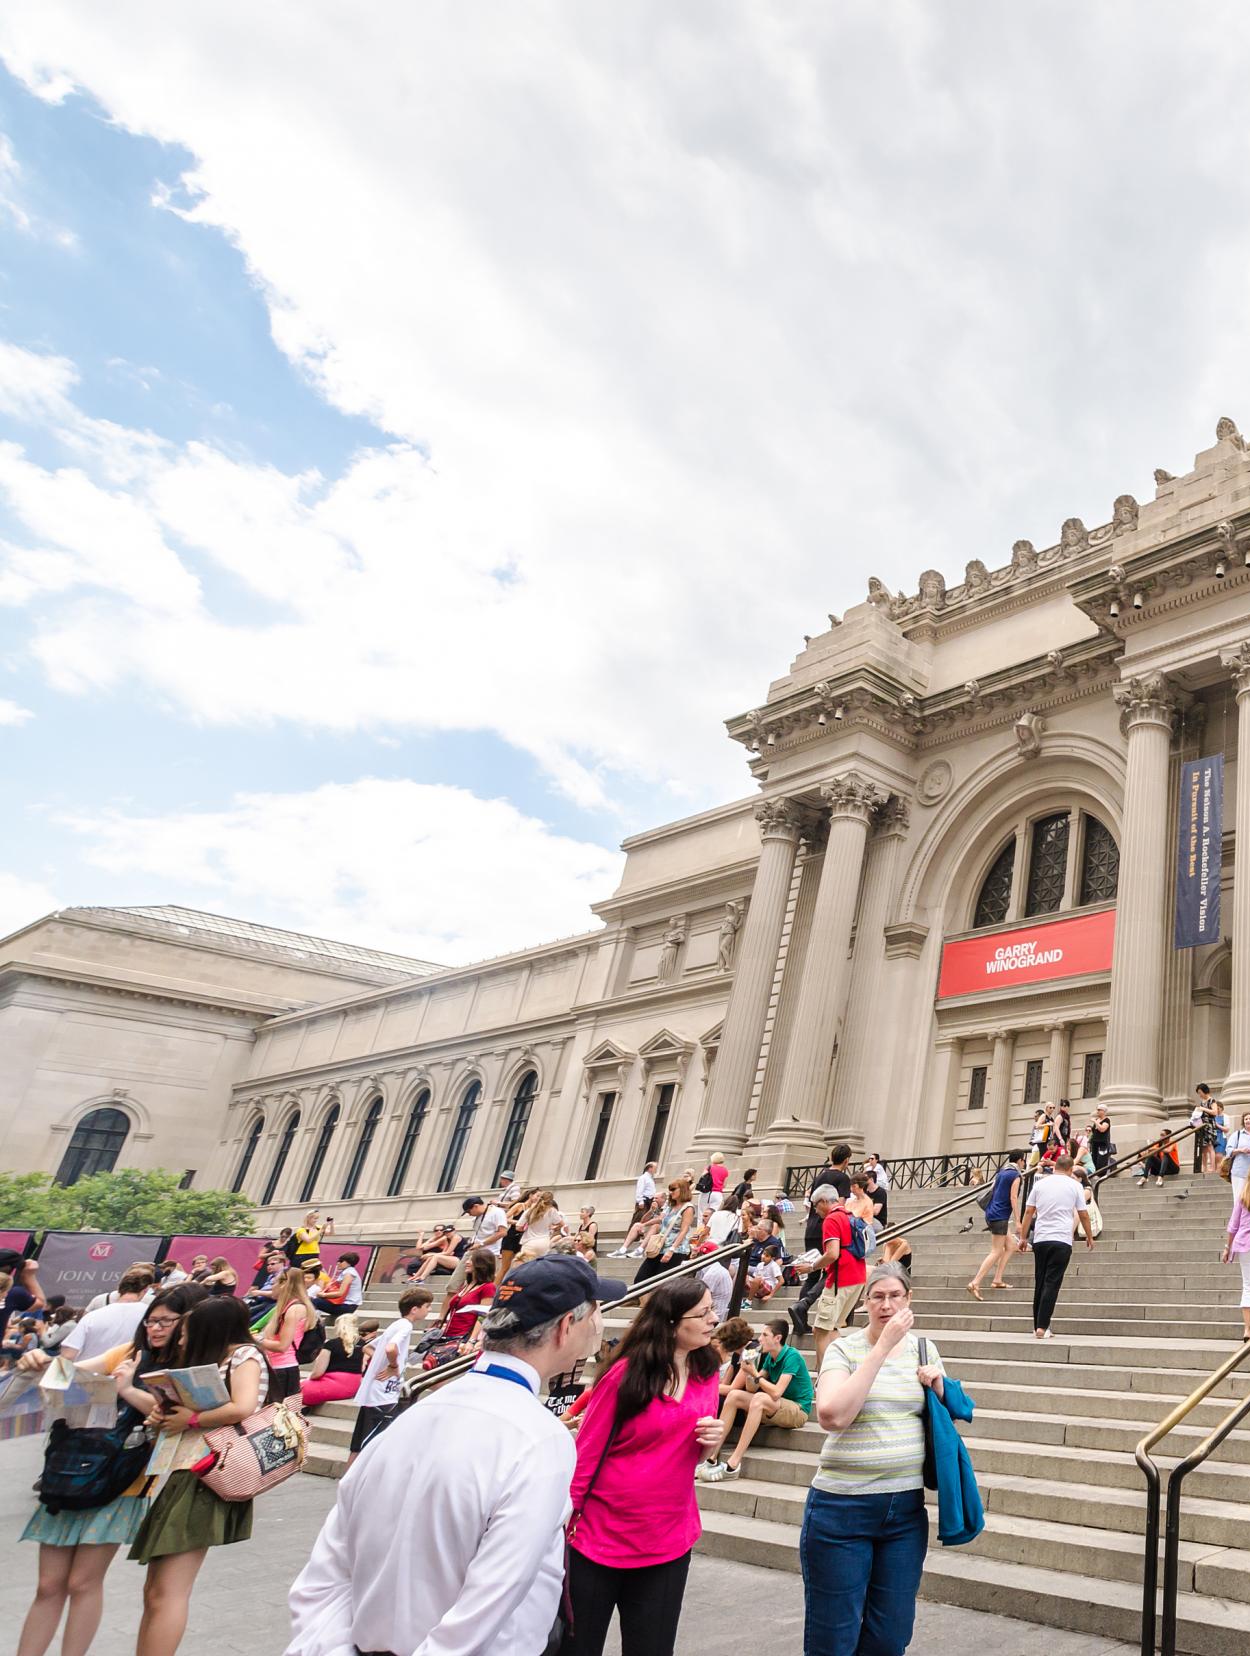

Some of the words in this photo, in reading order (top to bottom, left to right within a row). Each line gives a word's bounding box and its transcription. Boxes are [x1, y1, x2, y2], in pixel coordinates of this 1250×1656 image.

[1192, 771, 1200, 783] In
[1204, 767, 1212, 787] The
[1191, 783, 1199, 822] Pursuit
[1203, 788, 1211, 824] Nelson
[1190, 823, 1198, 834] of
[1202, 825, 1210, 836] A.
[1189, 853, 1197, 878] Best
[1200, 838, 1210, 896] Rockefeller
[1199, 898, 1208, 932] Vision
[986, 948, 1063, 975] WINOGRAND
[994, 940, 1038, 961] GARRY
[56, 1270, 97, 1283] JOIN
